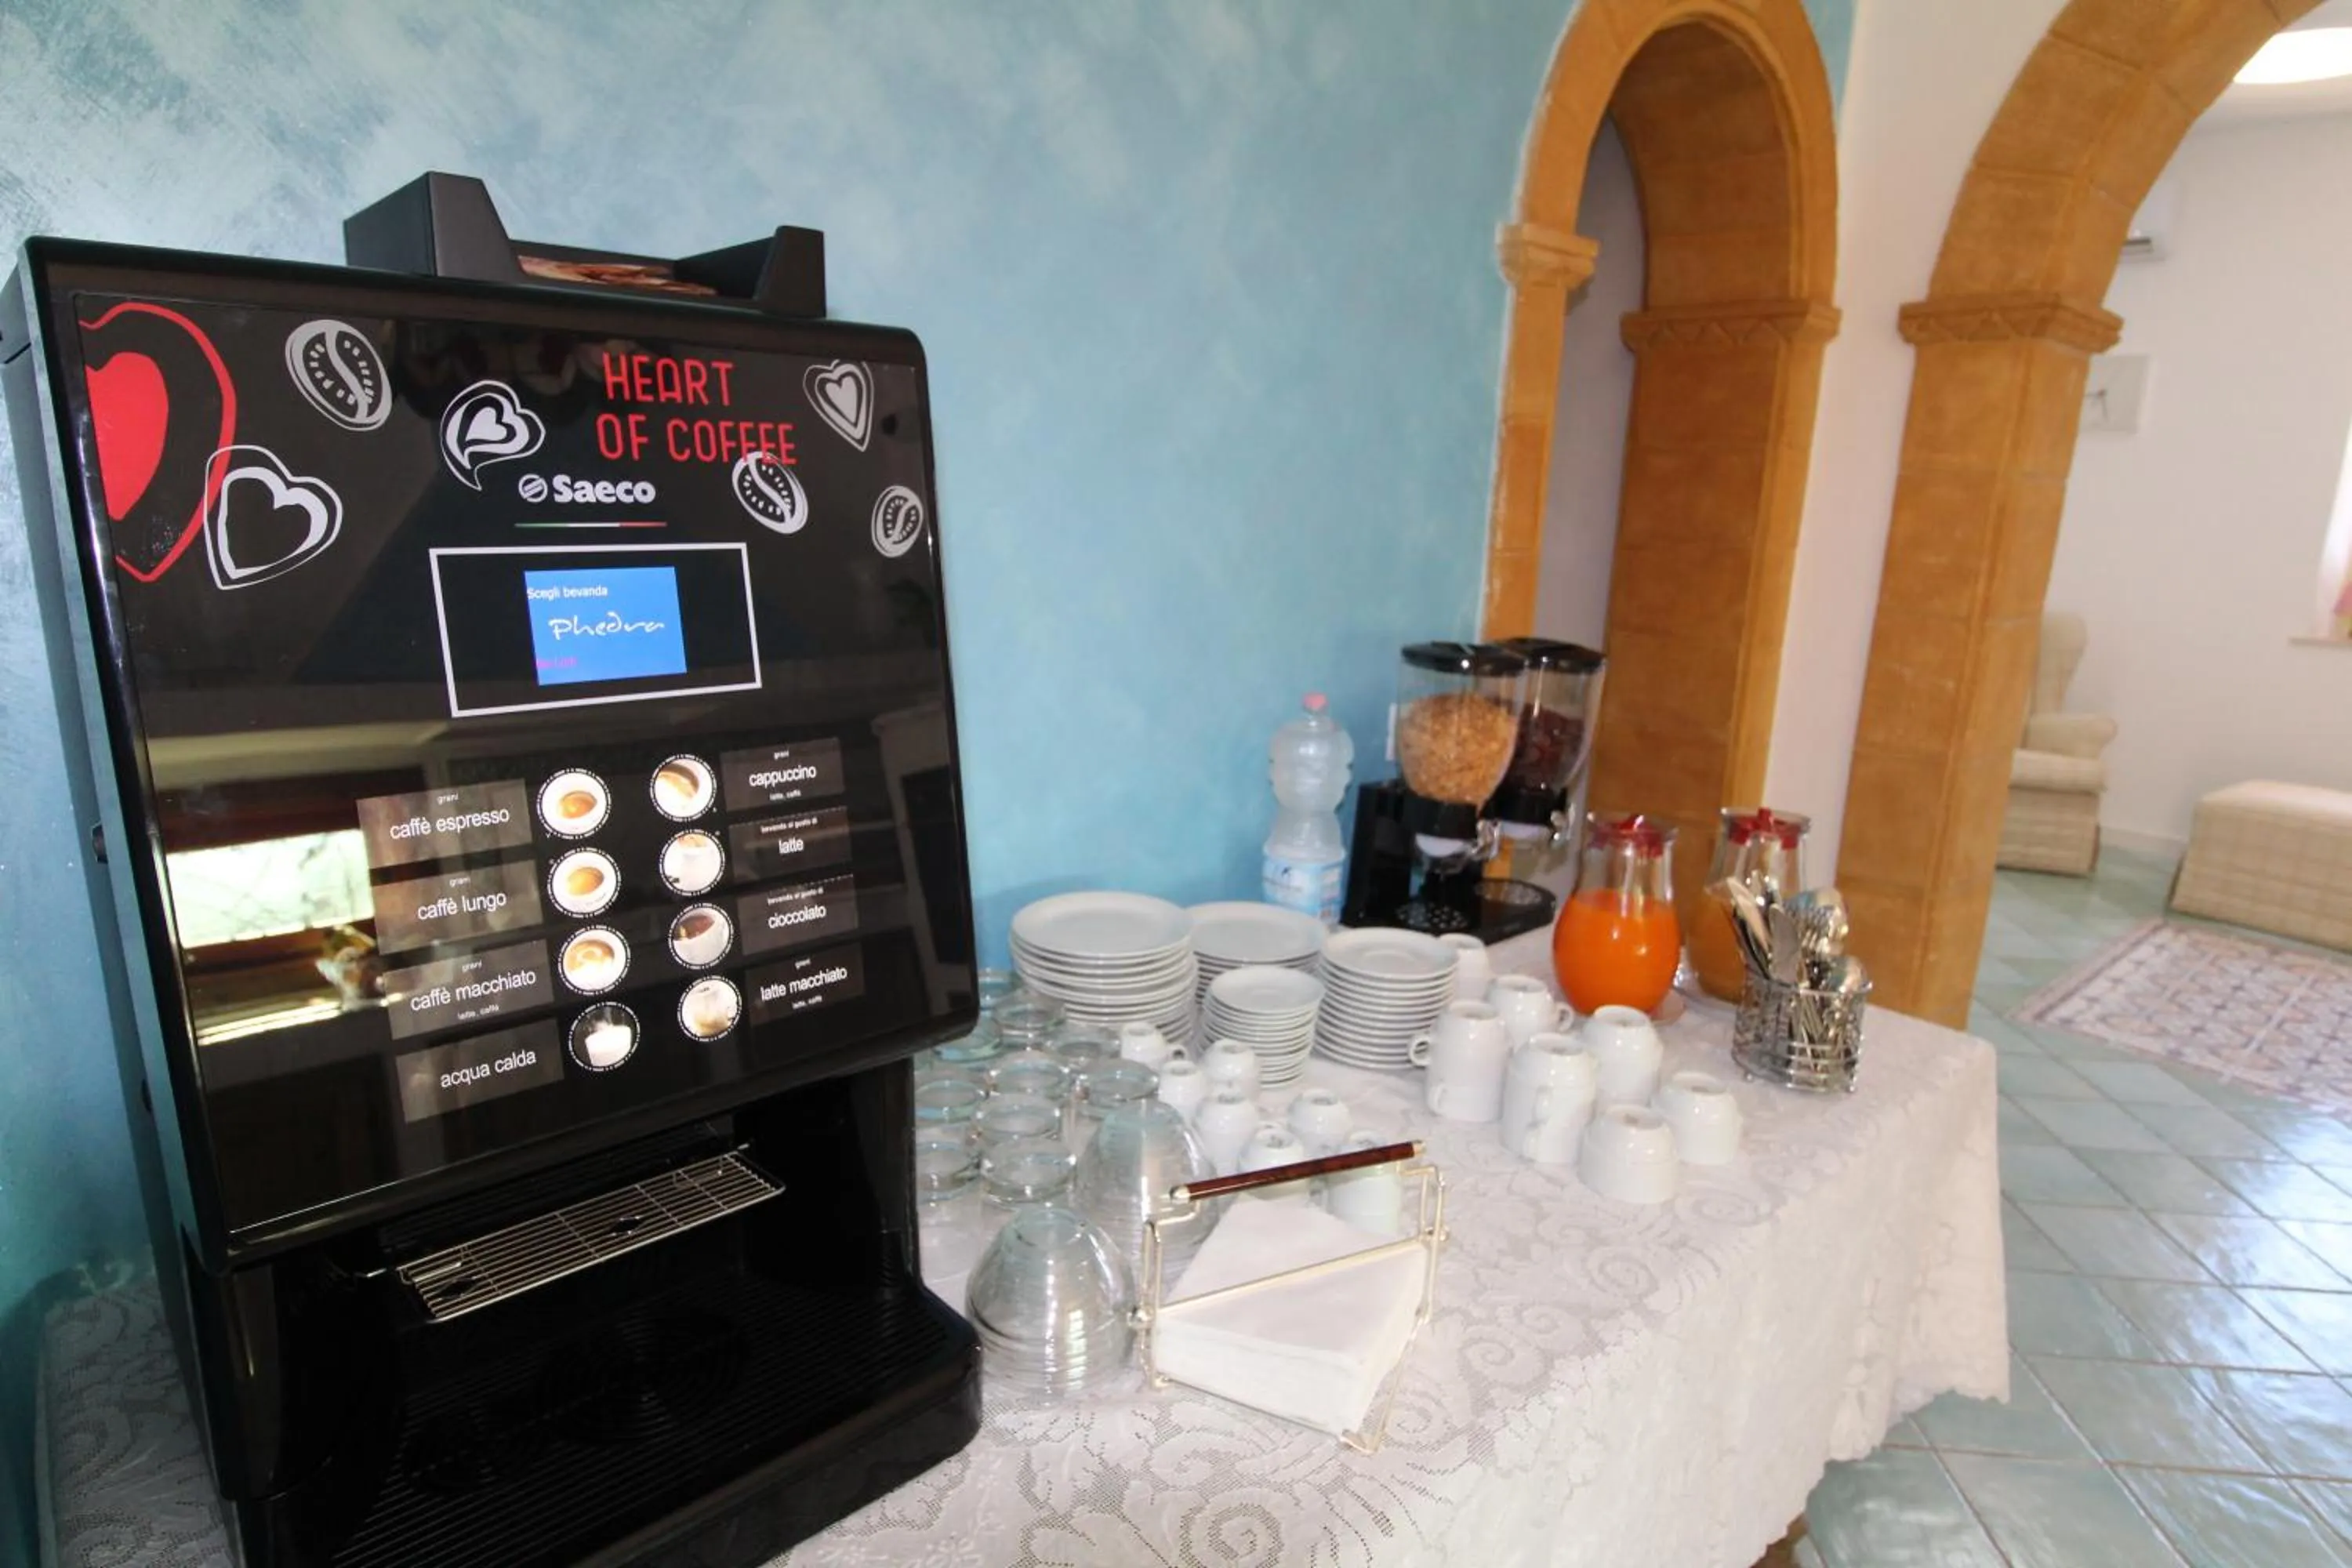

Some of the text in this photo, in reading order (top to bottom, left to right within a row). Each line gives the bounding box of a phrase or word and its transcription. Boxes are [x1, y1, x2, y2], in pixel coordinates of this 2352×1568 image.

[602, 352, 735, 407] HEART
[596, 413, 797, 465] OF COFFEE
[552, 474, 656, 503] Saeco
[527, 585, 608, 601] Scegli bevanda
[548, 611, 665, 641] Phedra
[749, 765, 817, 789] cappuccino
[390, 808, 510, 840] caffè espresso
[779, 837, 804, 855] latte
[418, 892, 506, 920] caffè lungo
[768, 905, 827, 929] cioccolato
[410, 970, 536, 1011] caffè macchiato
[760, 967, 848, 1001] latte macchiato
[441, 1049, 536, 1088] acqua calda
